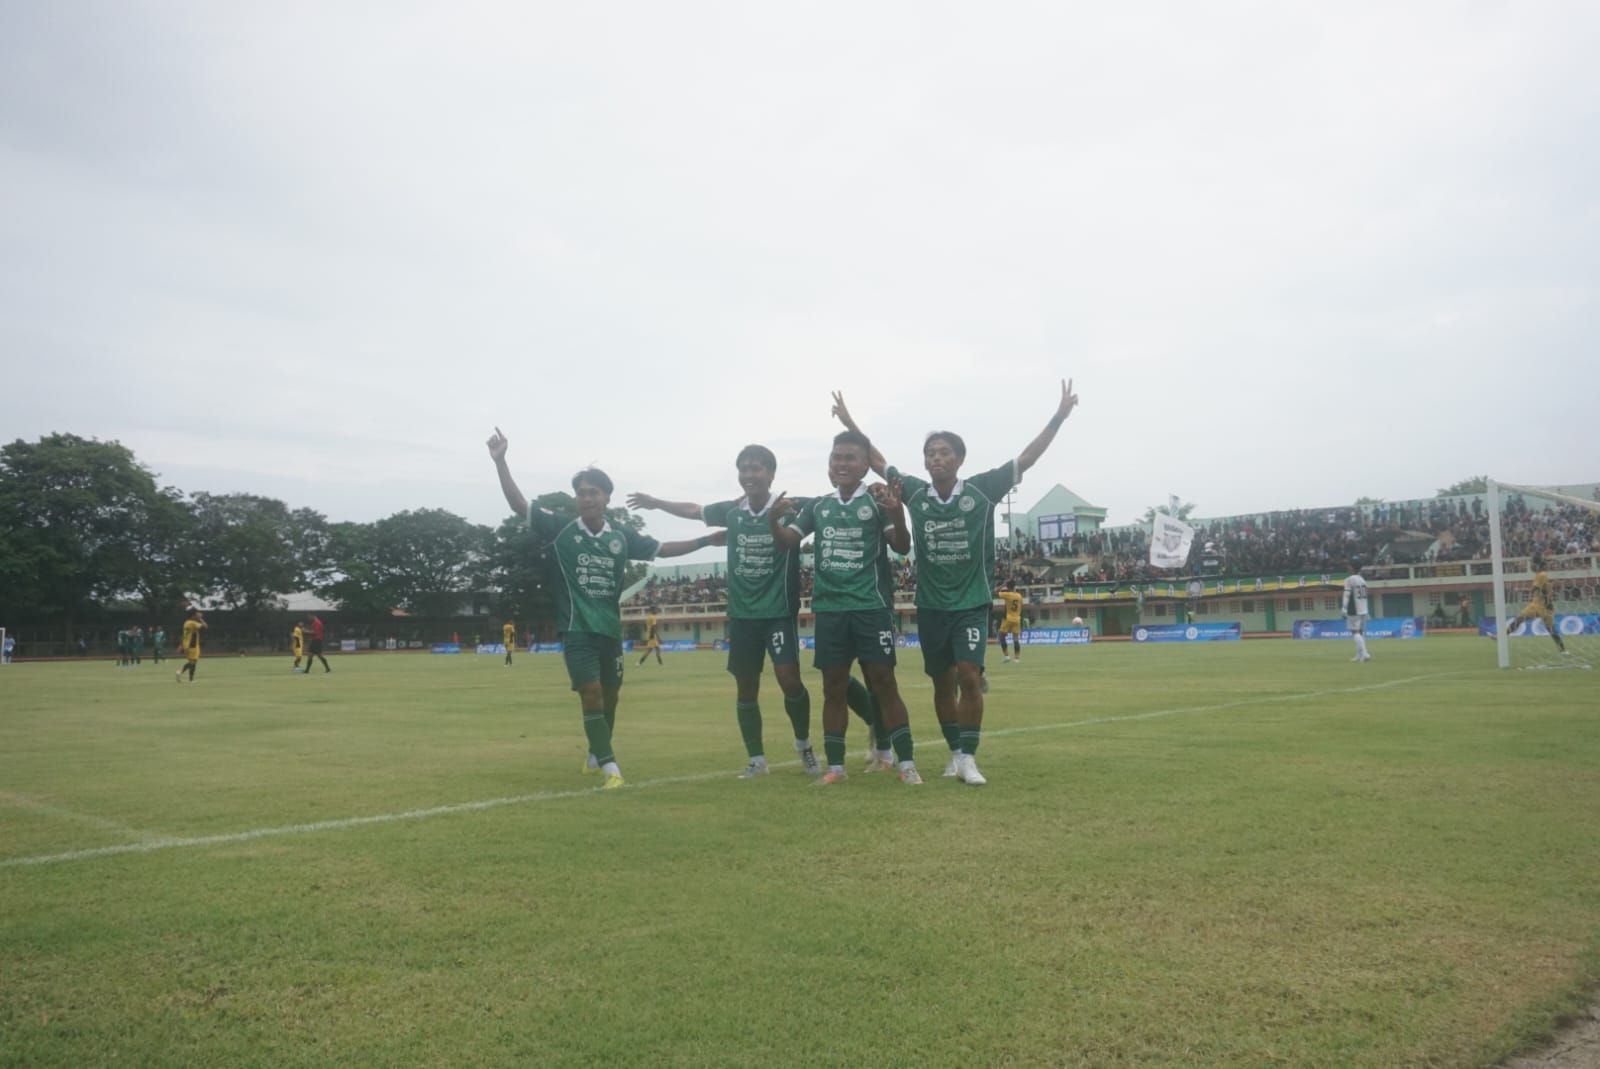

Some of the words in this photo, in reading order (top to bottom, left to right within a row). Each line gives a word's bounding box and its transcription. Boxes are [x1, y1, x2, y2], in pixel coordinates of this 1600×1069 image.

[771, 630, 784, 647] 21
[878, 630, 893, 646] 29
[966, 627, 980, 643] 13
